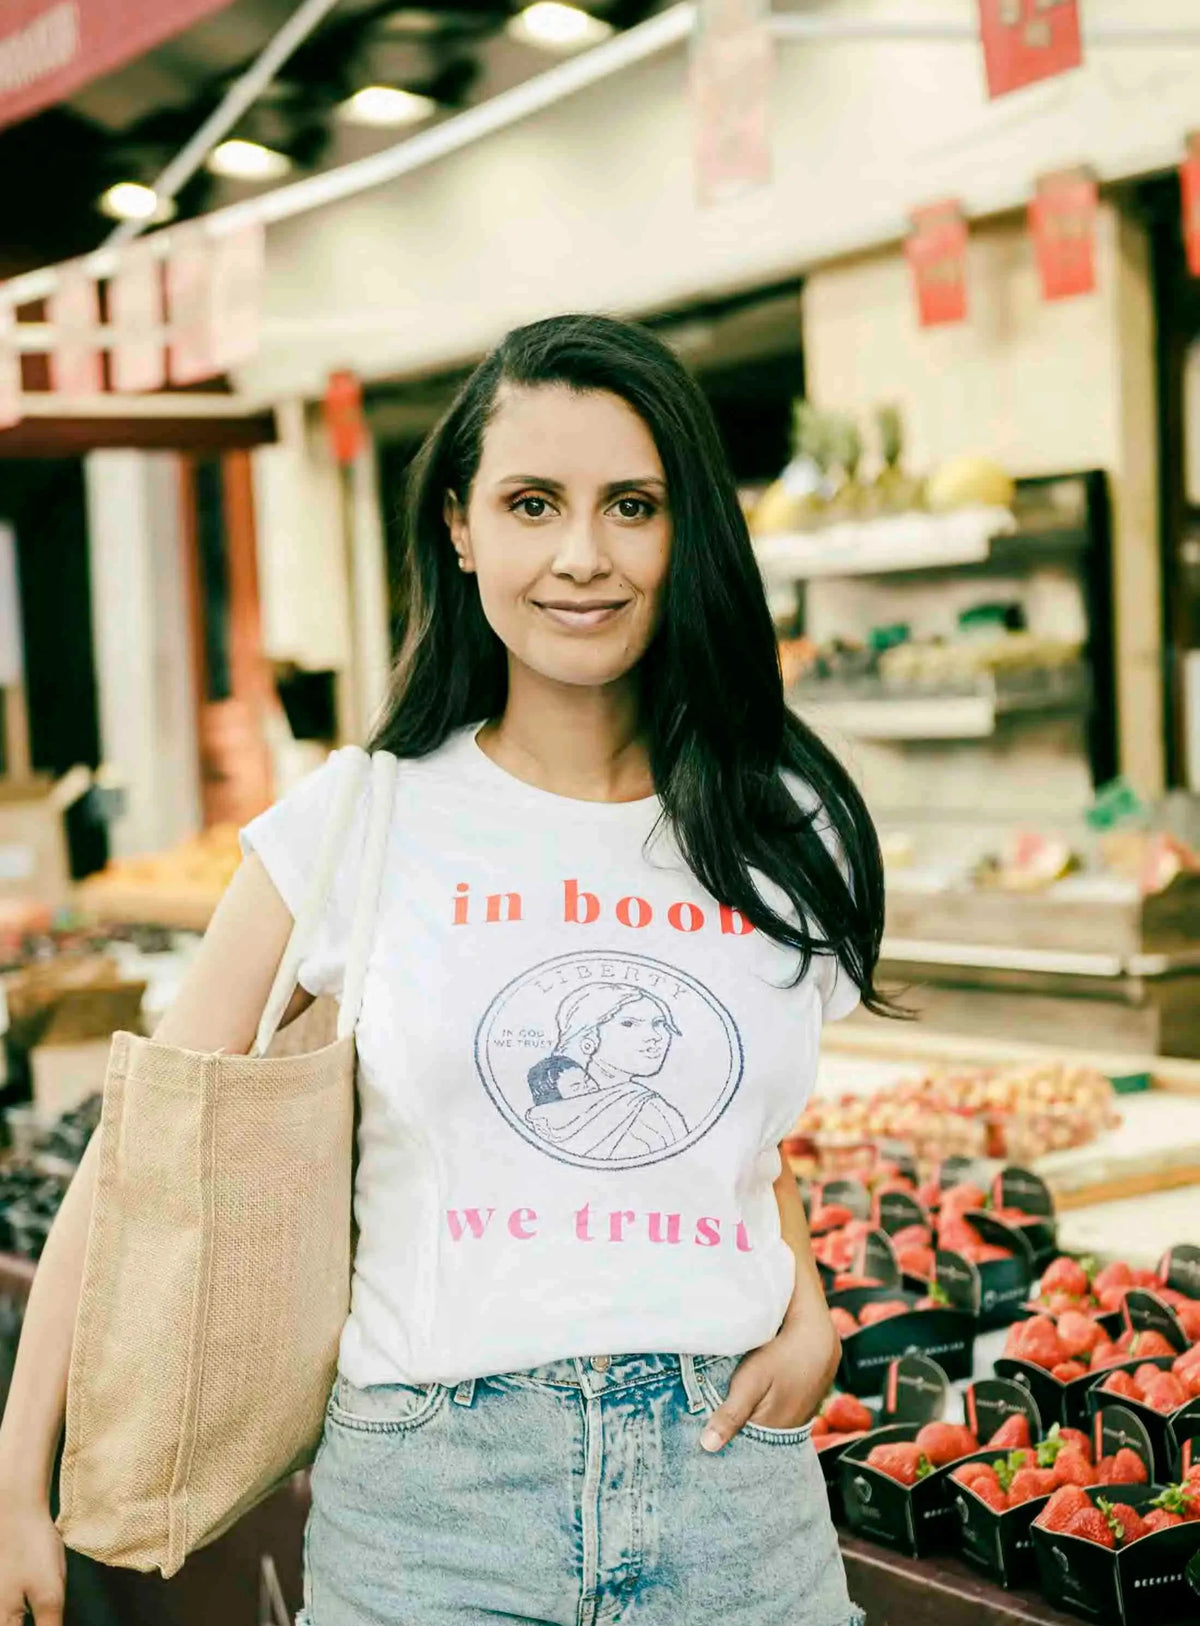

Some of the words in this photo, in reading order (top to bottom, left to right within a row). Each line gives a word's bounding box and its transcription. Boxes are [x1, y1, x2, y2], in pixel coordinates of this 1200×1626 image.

[451, 882, 522, 925] in
[534, 964, 687, 999] LIBERTY
[493, 1039, 512, 1048] WE
[517, 1039, 553, 1048] TRUST
[502, 1029, 513, 1037] IN
[519, 1029, 545, 1038] GOD
[446, 1207, 538, 1242] we
[575, 1202, 754, 1252] trust
